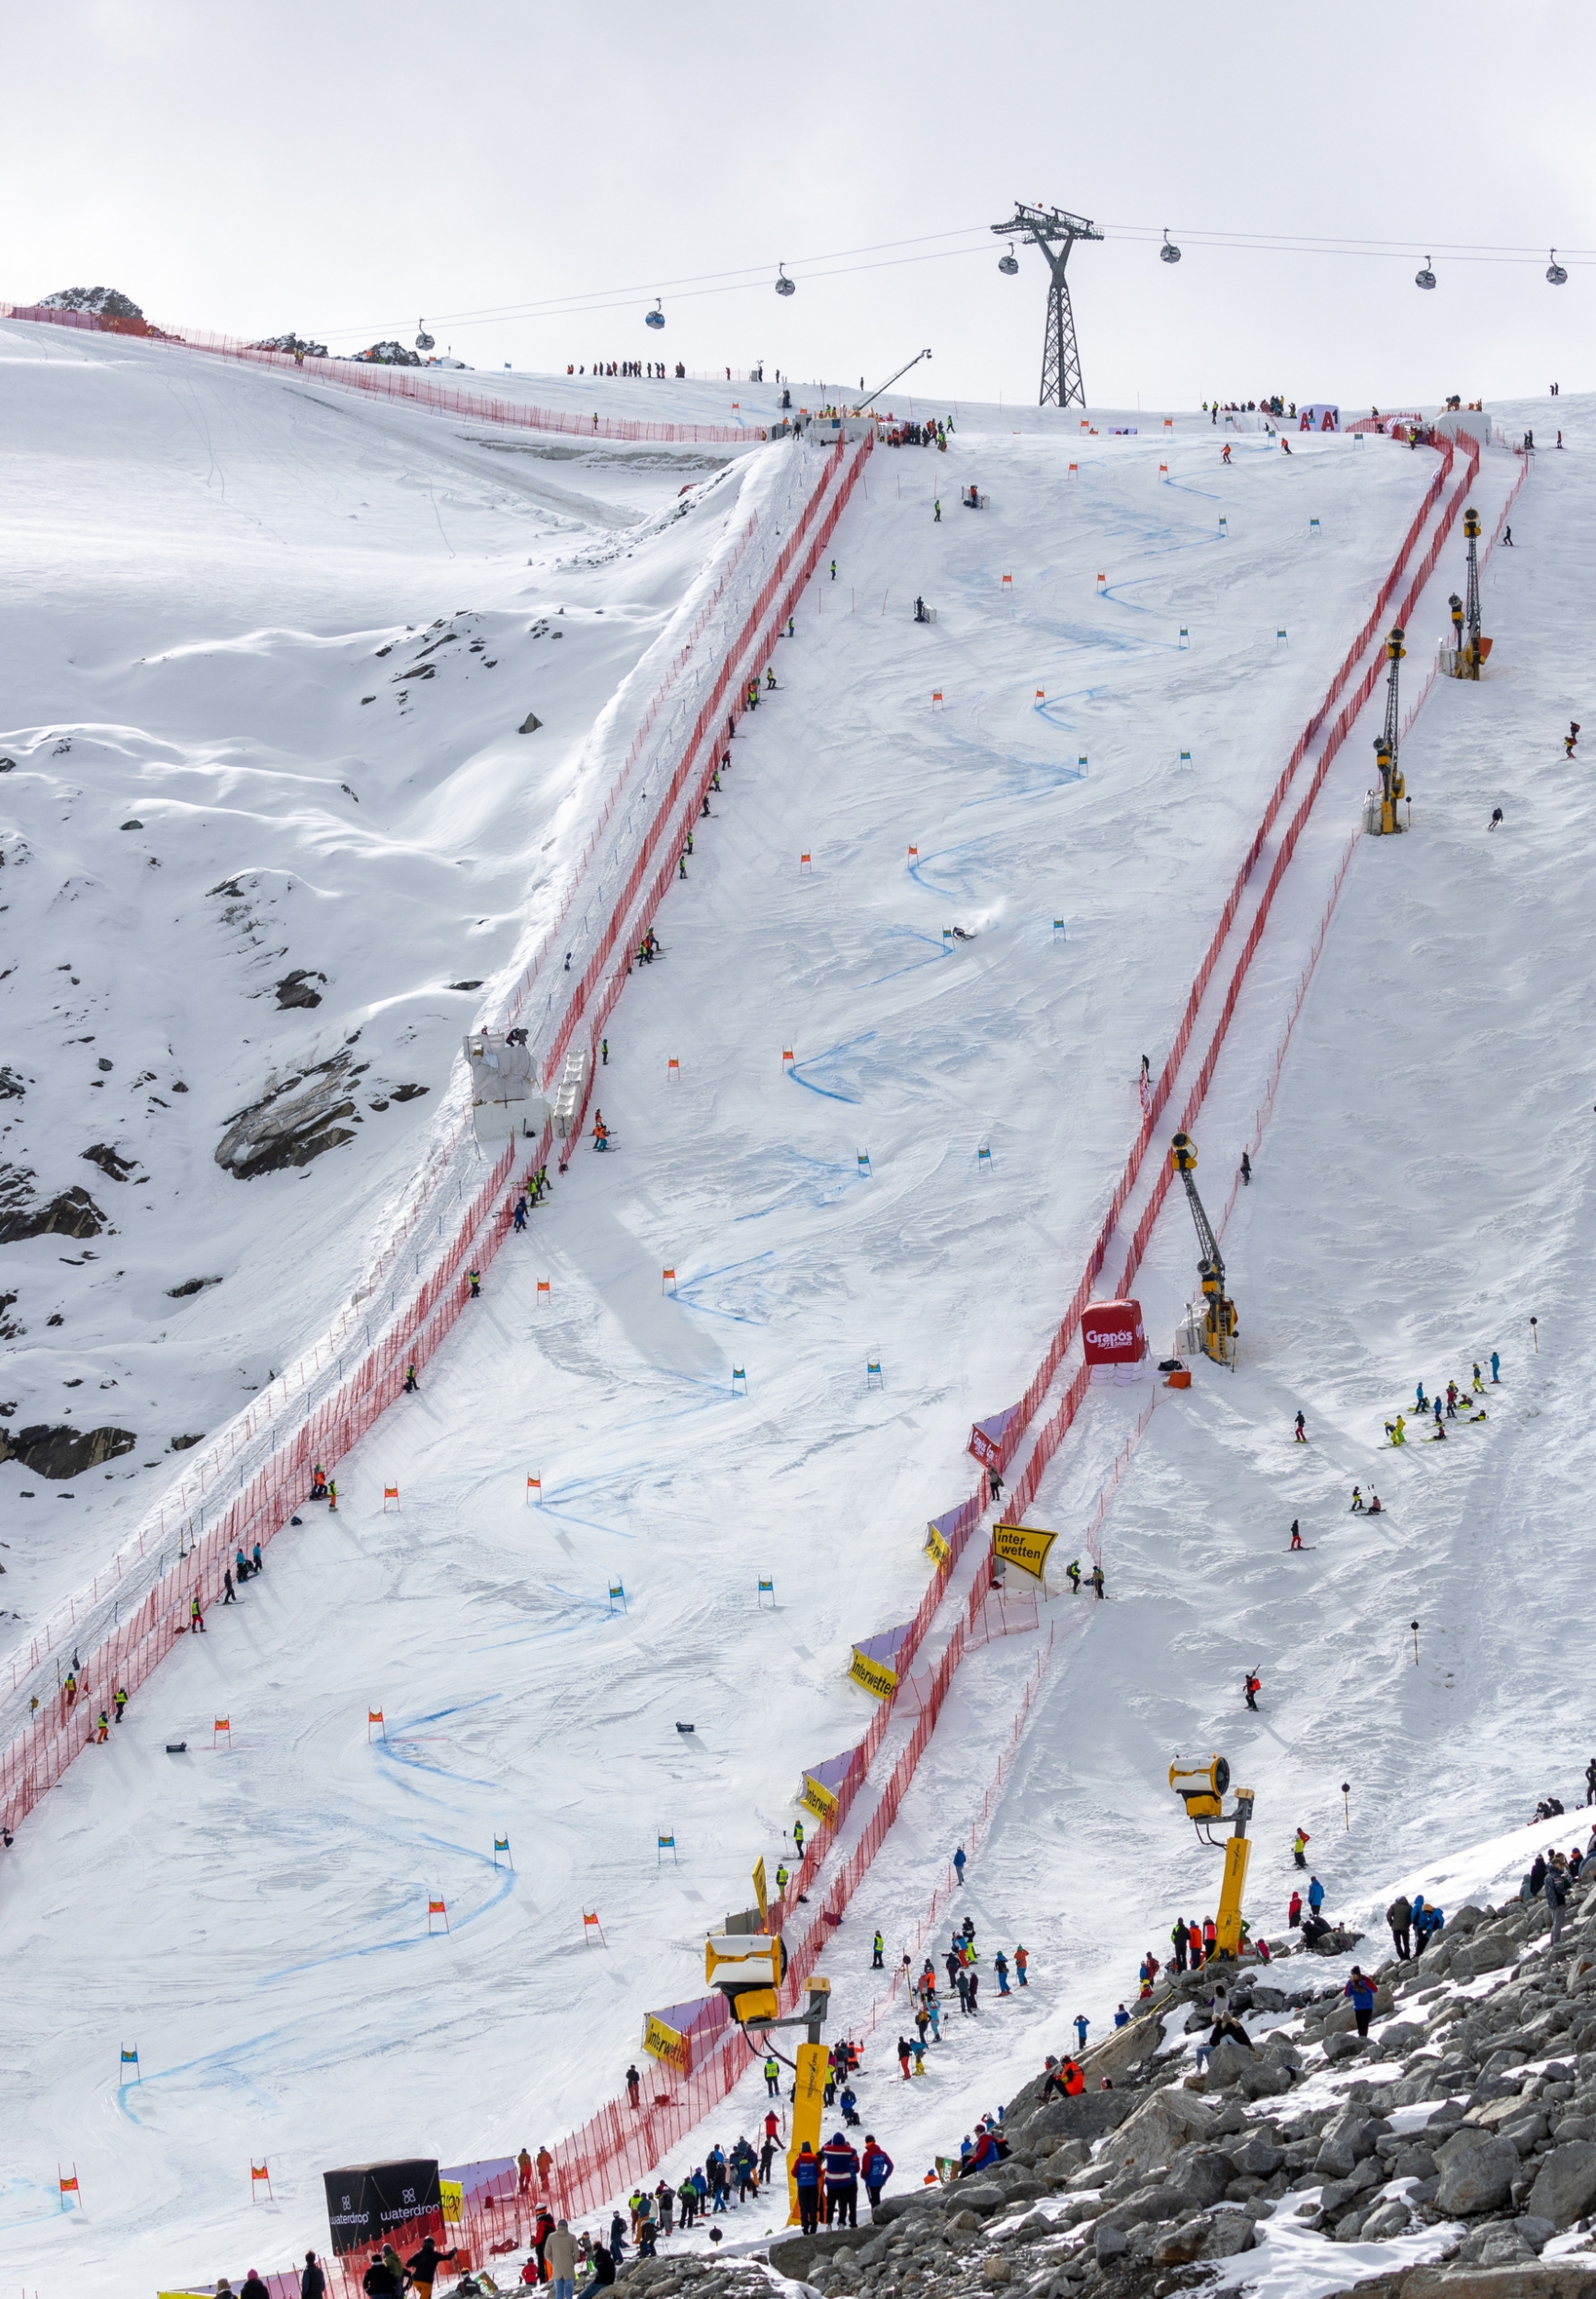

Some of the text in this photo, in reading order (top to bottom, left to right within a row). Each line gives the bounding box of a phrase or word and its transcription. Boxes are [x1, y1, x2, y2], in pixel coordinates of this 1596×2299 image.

[1299, 408, 1314, 431] A1
[1321, 409, 1338, 431] A1
[998, 1528, 1026, 1545] inter
[1001, 1546, 1041, 1560] wetten
[806, 1781, 836, 1824] interwette
[648, 2023, 685, 2065] interwette
[329, 2212, 370, 2225] waterdrop
